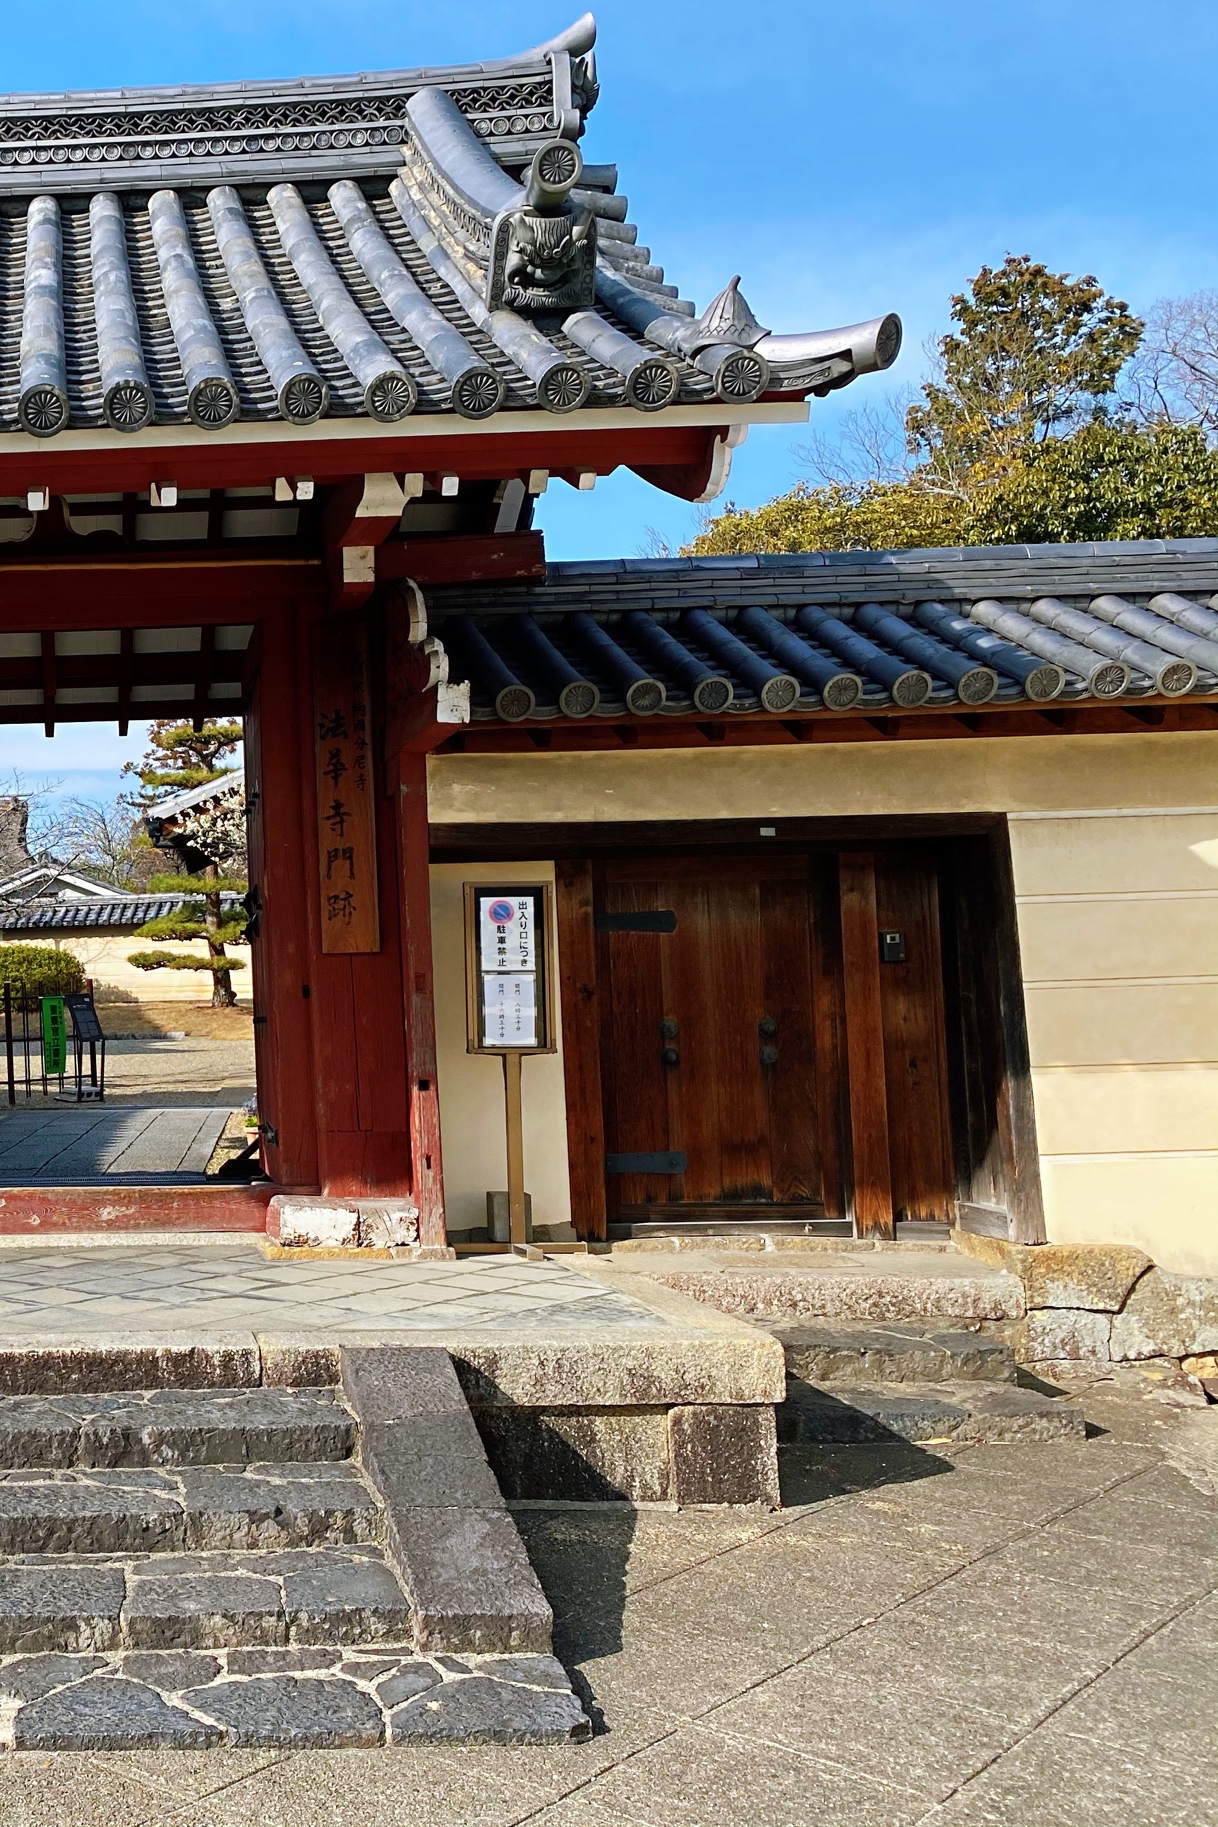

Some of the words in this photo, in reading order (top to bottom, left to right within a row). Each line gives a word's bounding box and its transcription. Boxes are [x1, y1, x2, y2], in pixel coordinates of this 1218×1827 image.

[317, 708, 358, 926] 法華寺門跡
[496, 924, 507, 967] 駐車禁止
[518, 900, 529, 967] 出入り口につき
